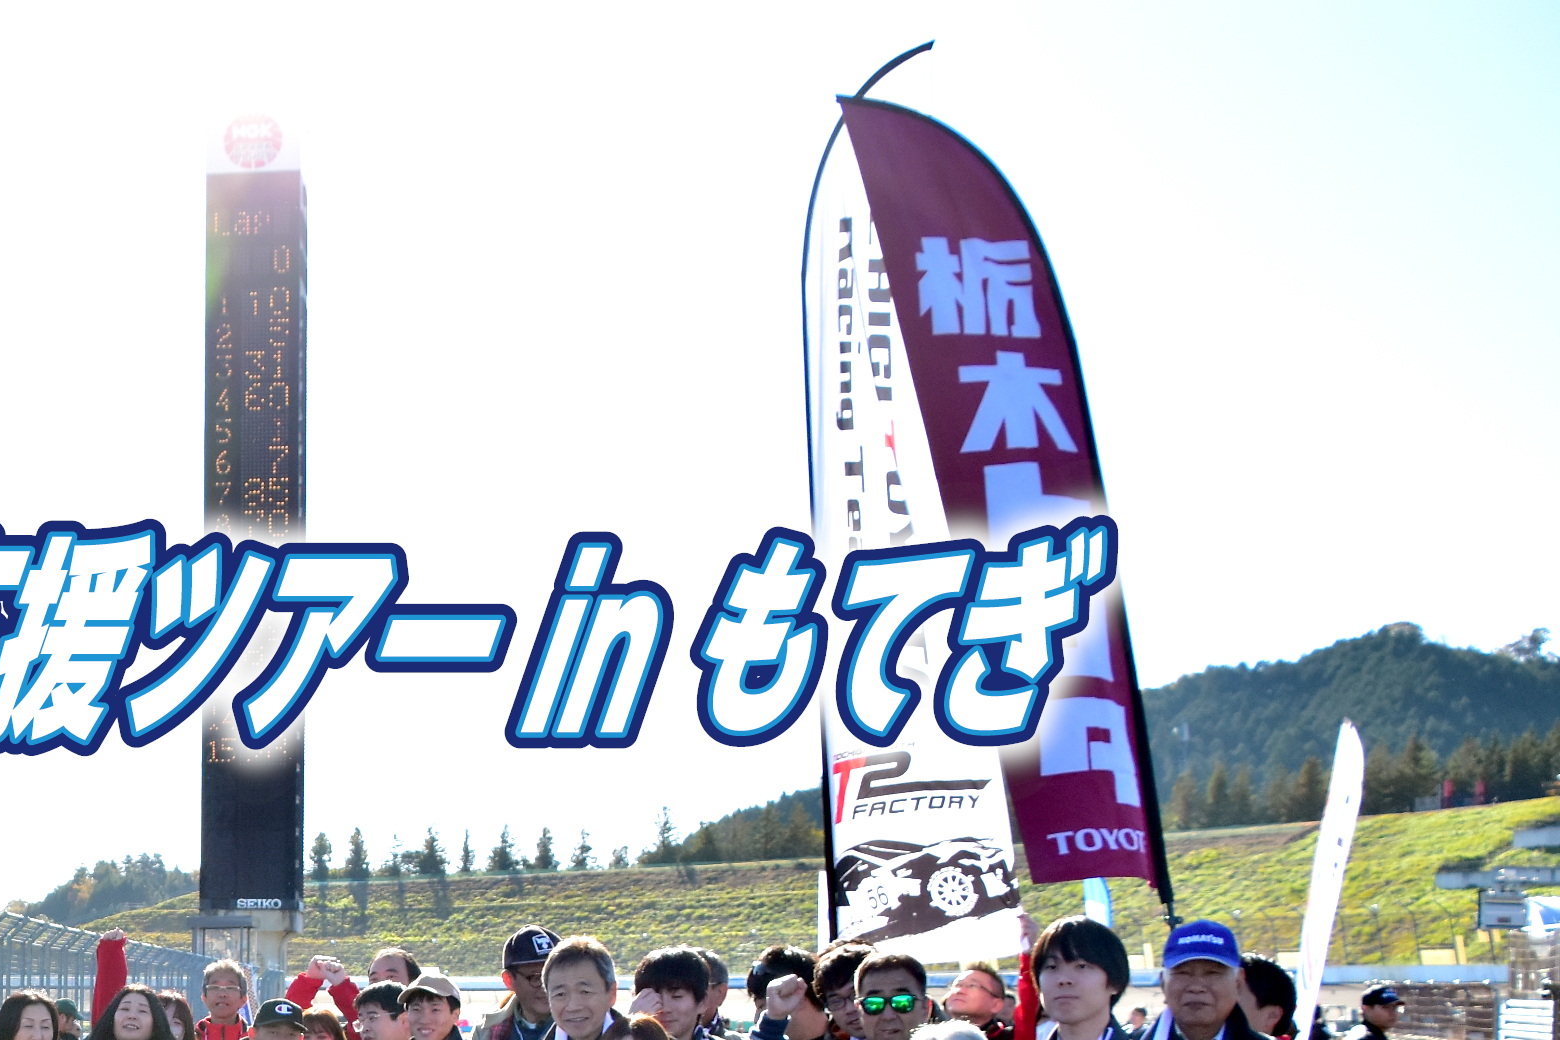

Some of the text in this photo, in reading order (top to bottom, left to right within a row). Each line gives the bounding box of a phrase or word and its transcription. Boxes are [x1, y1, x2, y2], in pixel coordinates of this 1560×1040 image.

[851, 795, 981, 820] FACTORY
[1046, 827, 1147, 856] TOYOT
[236, 897, 282, 909] SEIKO
[867, 884, 890, 910] 56
